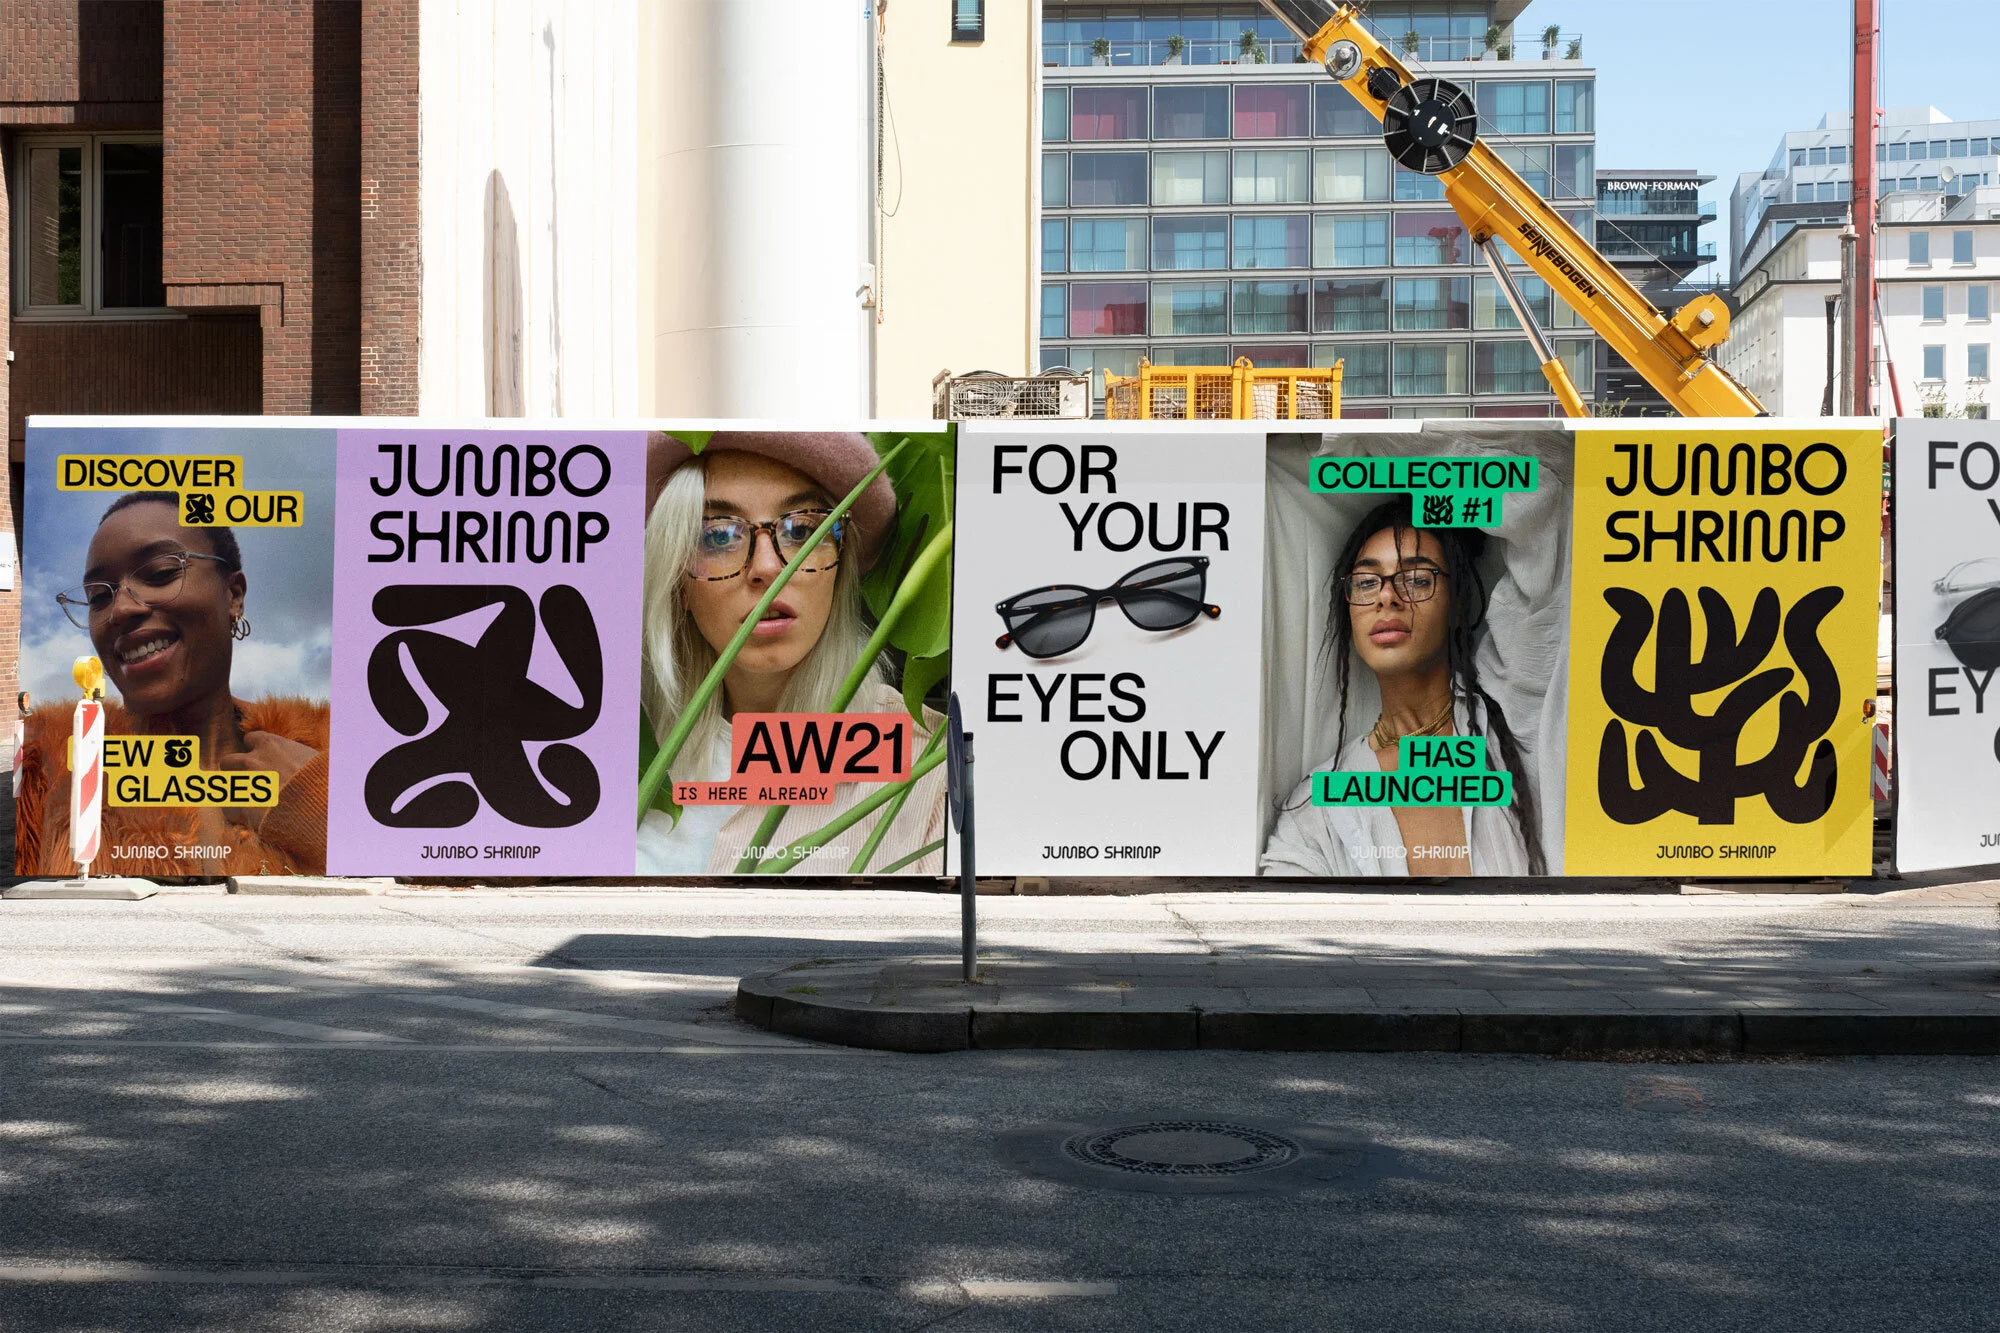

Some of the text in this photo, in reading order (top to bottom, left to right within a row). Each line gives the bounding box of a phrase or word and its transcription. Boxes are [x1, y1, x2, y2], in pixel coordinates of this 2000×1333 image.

[1607, 181, 1699, 191] BROWN-FORMAN
[64, 459, 236, 487] DISCOVER
[370, 444, 612, 498] JUMBO
[992, 444, 1118, 494] FOR
[1318, 461, 1531, 489] COLLECTION
[1606, 443, 1847, 497] JUMBO
[1928, 441, 2000, 491] FO
[225, 495, 298, 523] OUR
[1462, 497, 1493, 523] #1
[368, 510, 610, 564] SHRIMP
[1058, 502, 1230, 552] YOUR
[1604, 509, 1846, 563] SHRIMP
[987, 673, 1147, 724] EYES
[1928, 667, 1997, 716] EY
[103, 740, 154, 767] EW
[736, 721, 903, 774] AW21
[1060, 730, 1226, 781] ONLY
[1409, 740, 1476, 768] HAS
[116, 775, 272, 803] GLASSES
[678, 787, 828, 800] IS HERE ALREADY
[1323, 775, 1505, 803] LAUNCHED
[111, 846, 232, 859] JUMBO SHRIMP
[421, 846, 541, 859] JUMBO SHRIMP
[1043, 846, 1161, 859] JUMBO SHRIMP
[1412, 846, 1471, 859] SHRIMP
[1656, 846, 1776, 859] JUMBO SHRIMP
[1980, 833, 2000, 848] JU
